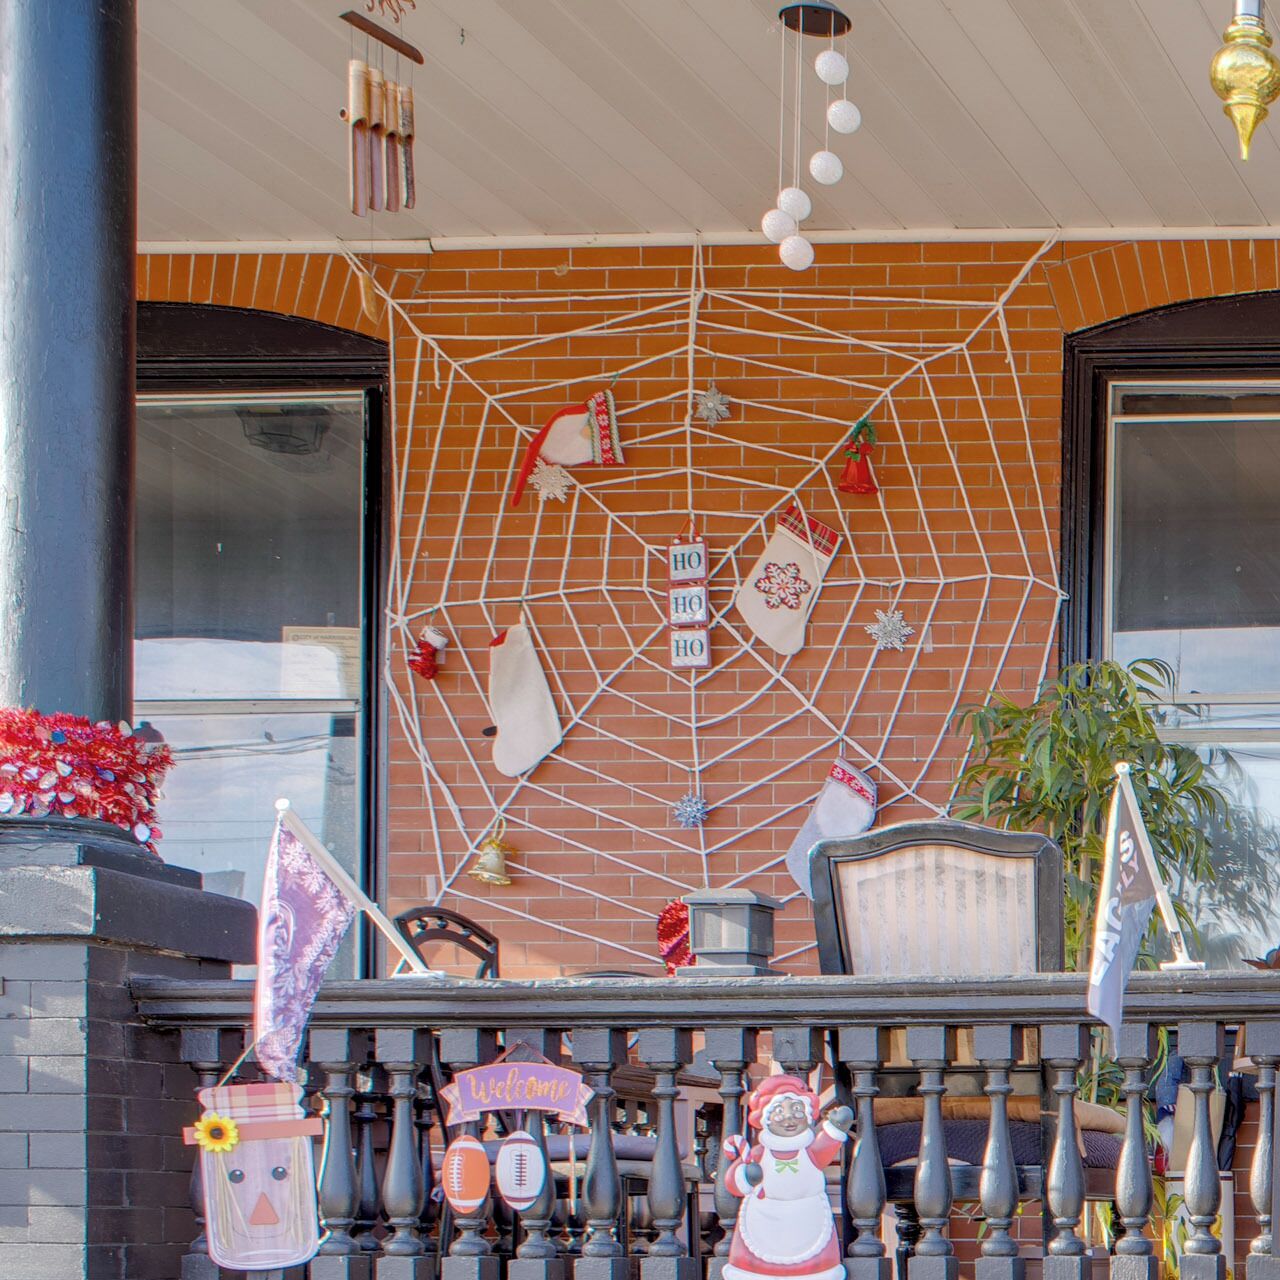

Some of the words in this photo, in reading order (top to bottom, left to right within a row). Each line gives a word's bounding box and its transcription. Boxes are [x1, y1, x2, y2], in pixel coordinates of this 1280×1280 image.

[672, 551, 702, 571] HO
[673, 594, 702, 614] HO
[674, 638, 704, 657] HO
[1090, 830, 1134, 986] EAGS
[466, 1067, 573, 1104] Welcome
